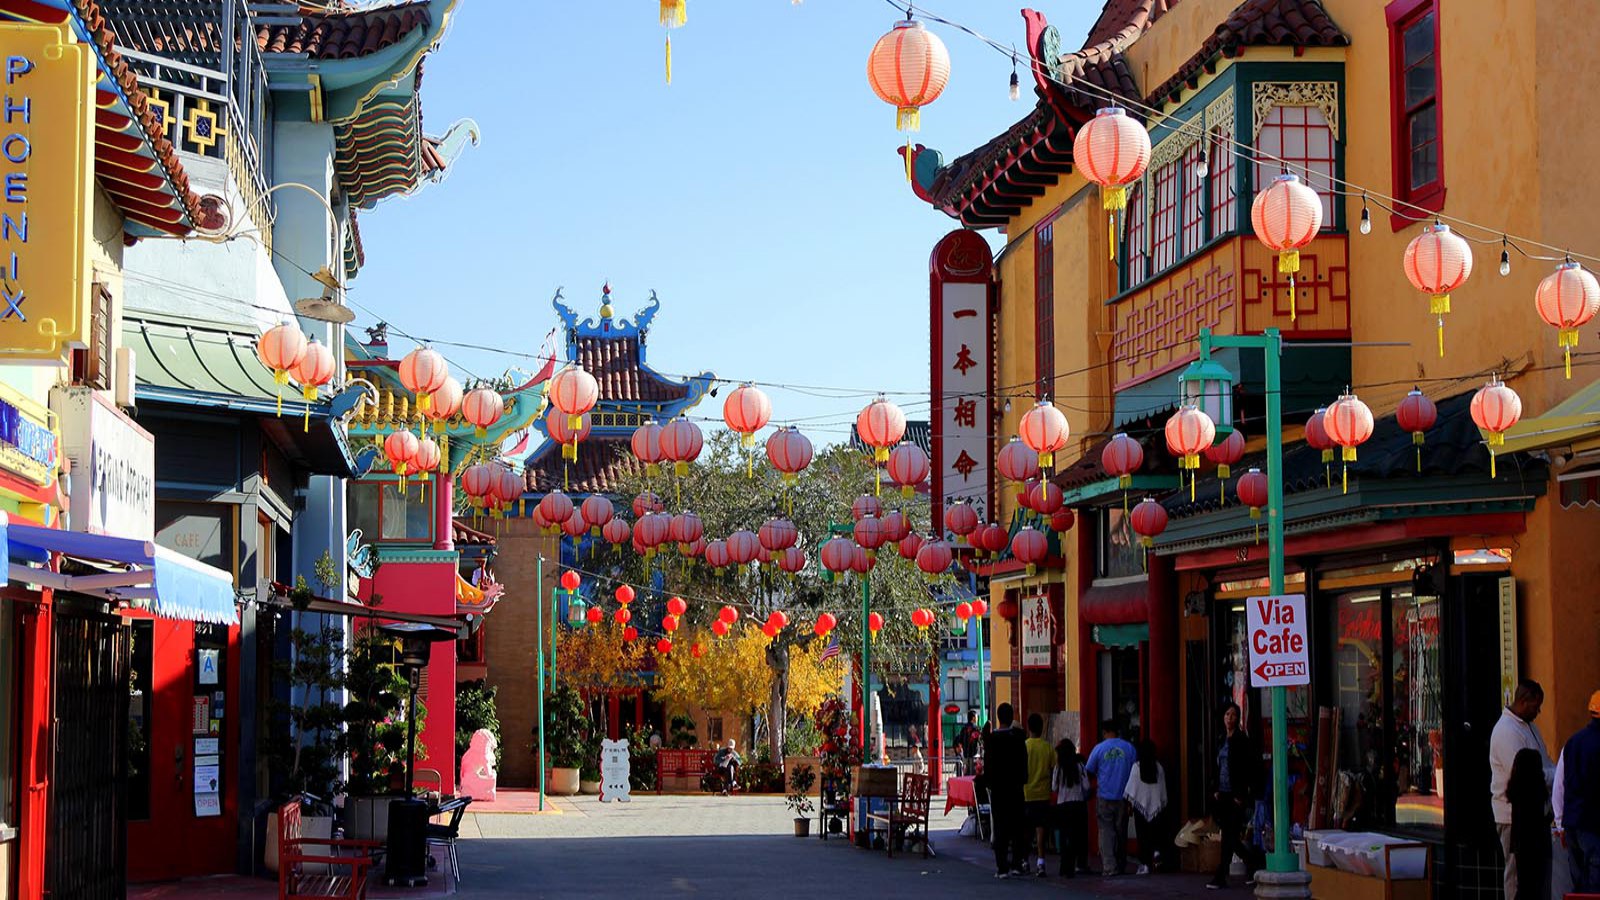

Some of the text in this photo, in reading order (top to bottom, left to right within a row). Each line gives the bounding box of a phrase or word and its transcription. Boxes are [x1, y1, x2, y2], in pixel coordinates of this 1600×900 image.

[0, 55, 31, 321] PHOENIX
[952, 308, 978, 482] 一本相命
[175, 532, 200, 547] CAFE
[1257, 599, 1295, 625] Via
[1253, 627, 1303, 655] Cafe
[203, 656, 214, 673] A
[1263, 663, 1305, 677] OPEN
[197, 798, 218, 809] OPEN
